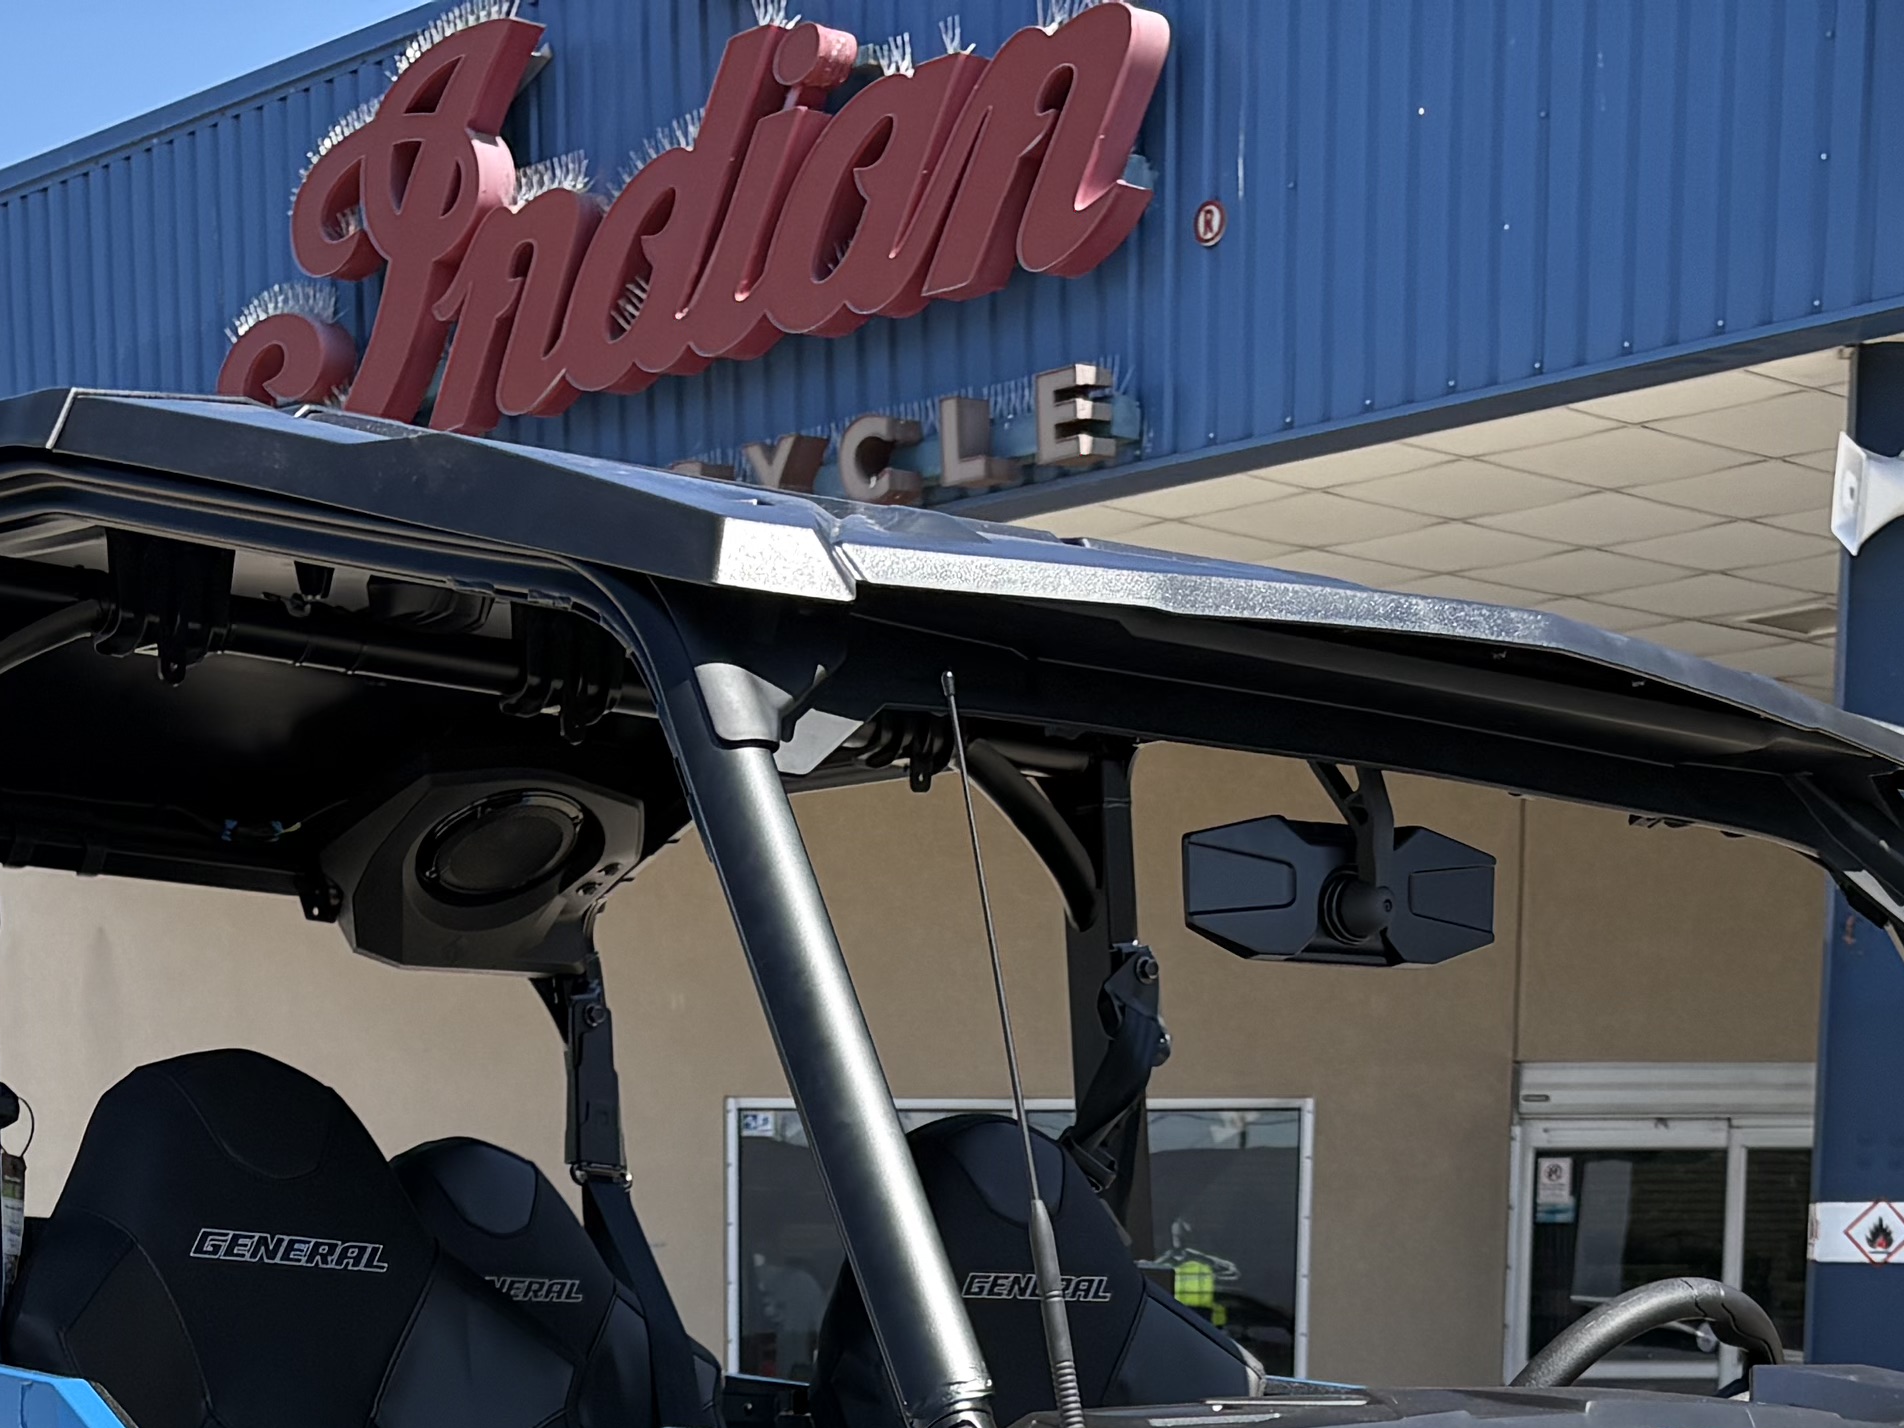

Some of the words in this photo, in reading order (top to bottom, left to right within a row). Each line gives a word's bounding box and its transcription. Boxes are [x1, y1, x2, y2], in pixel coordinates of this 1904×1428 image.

[218, 5, 1172, 434] Indian
[673, 363, 1116, 503] YCLE
[189, 1228, 388, 1273] GENERAL
